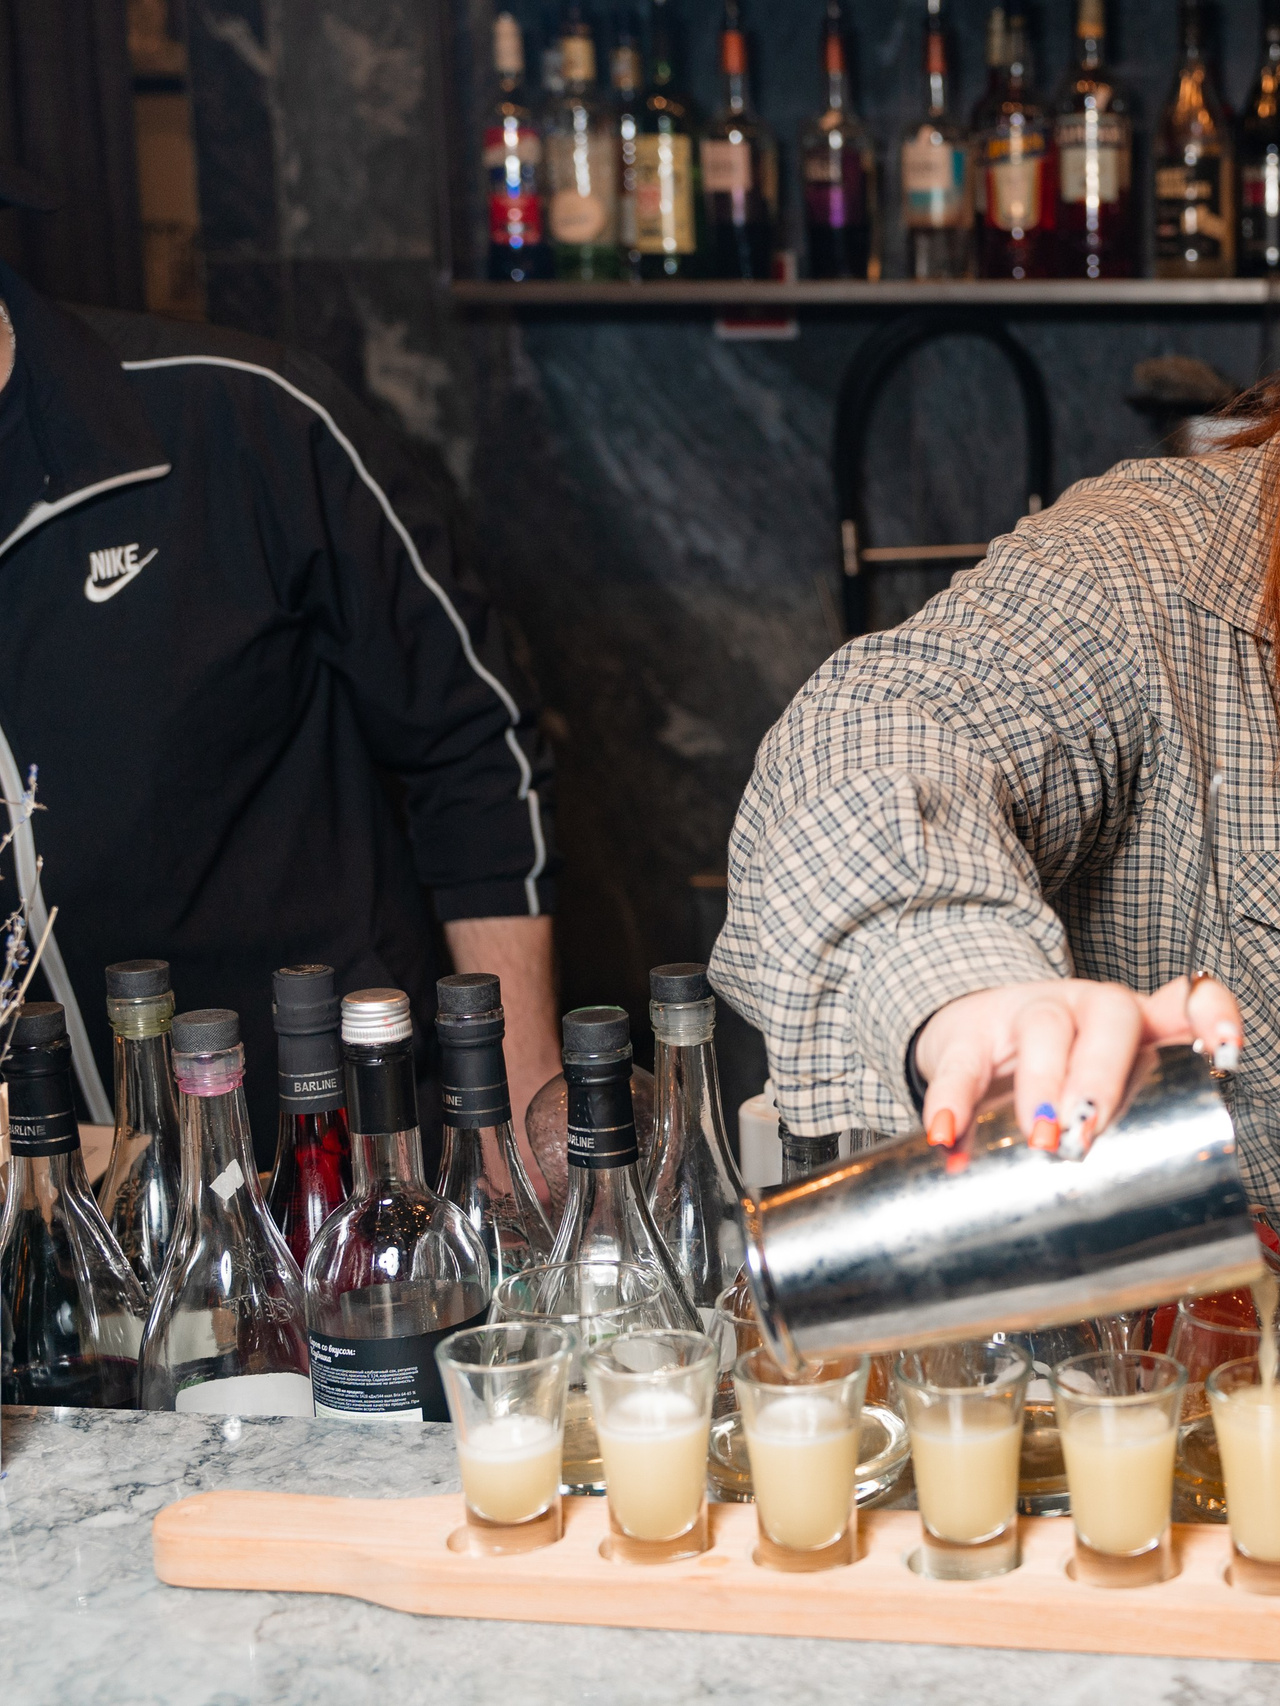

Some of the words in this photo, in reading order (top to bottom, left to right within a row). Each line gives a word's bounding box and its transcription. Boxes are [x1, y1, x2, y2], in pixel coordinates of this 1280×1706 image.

[89, 542, 140, 582] NIKE
[294, 1078, 337, 1093] BARLINE
[328, 1345, 356, 1357] вкусом:
